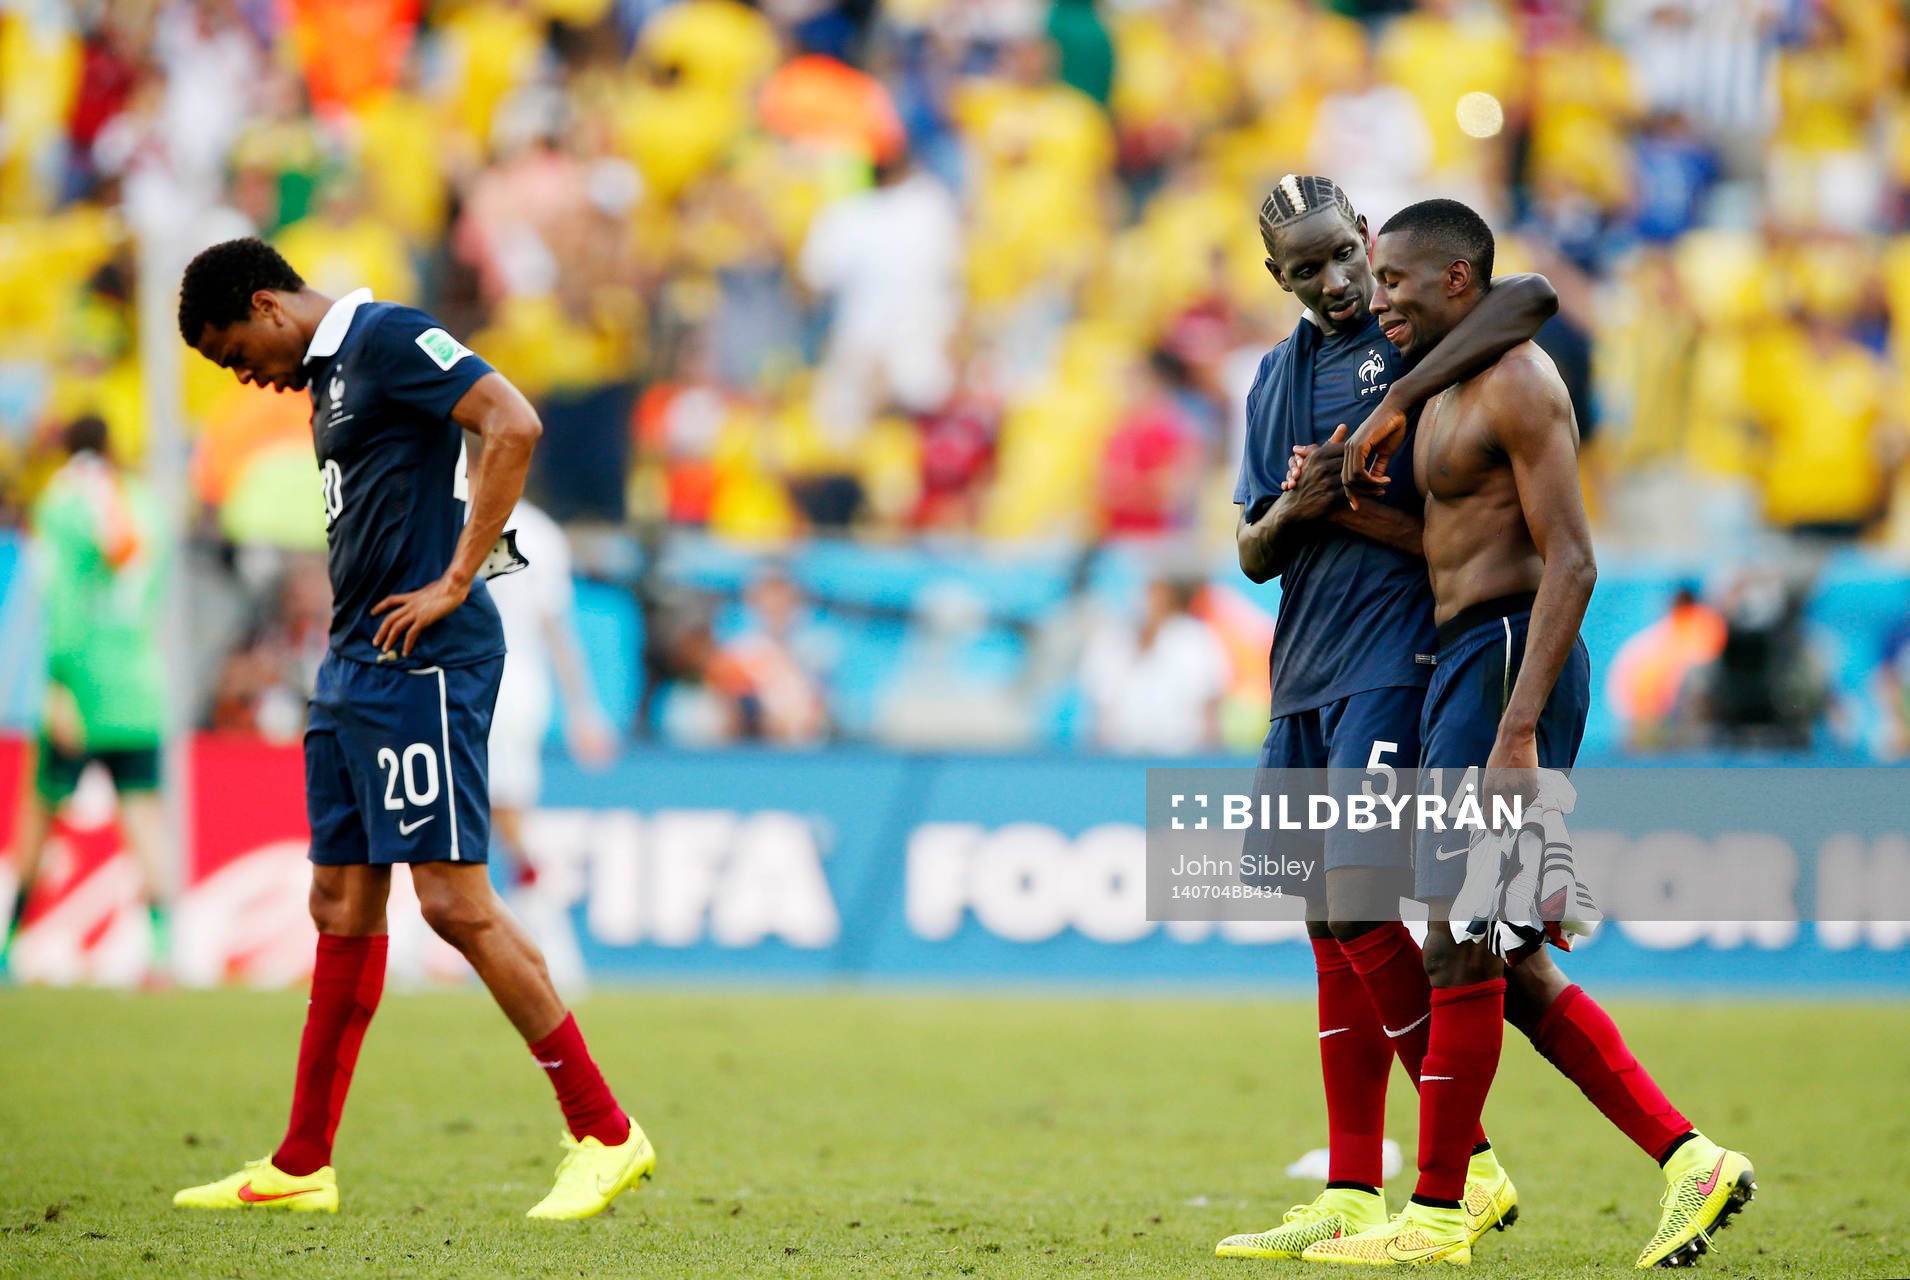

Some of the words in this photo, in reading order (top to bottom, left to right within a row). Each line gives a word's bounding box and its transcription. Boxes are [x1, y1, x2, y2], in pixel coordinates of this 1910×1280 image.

[1361, 383, 1388, 396] FFF
[377, 742, 440, 811] 20
[1361, 740, 1398, 806] 5
